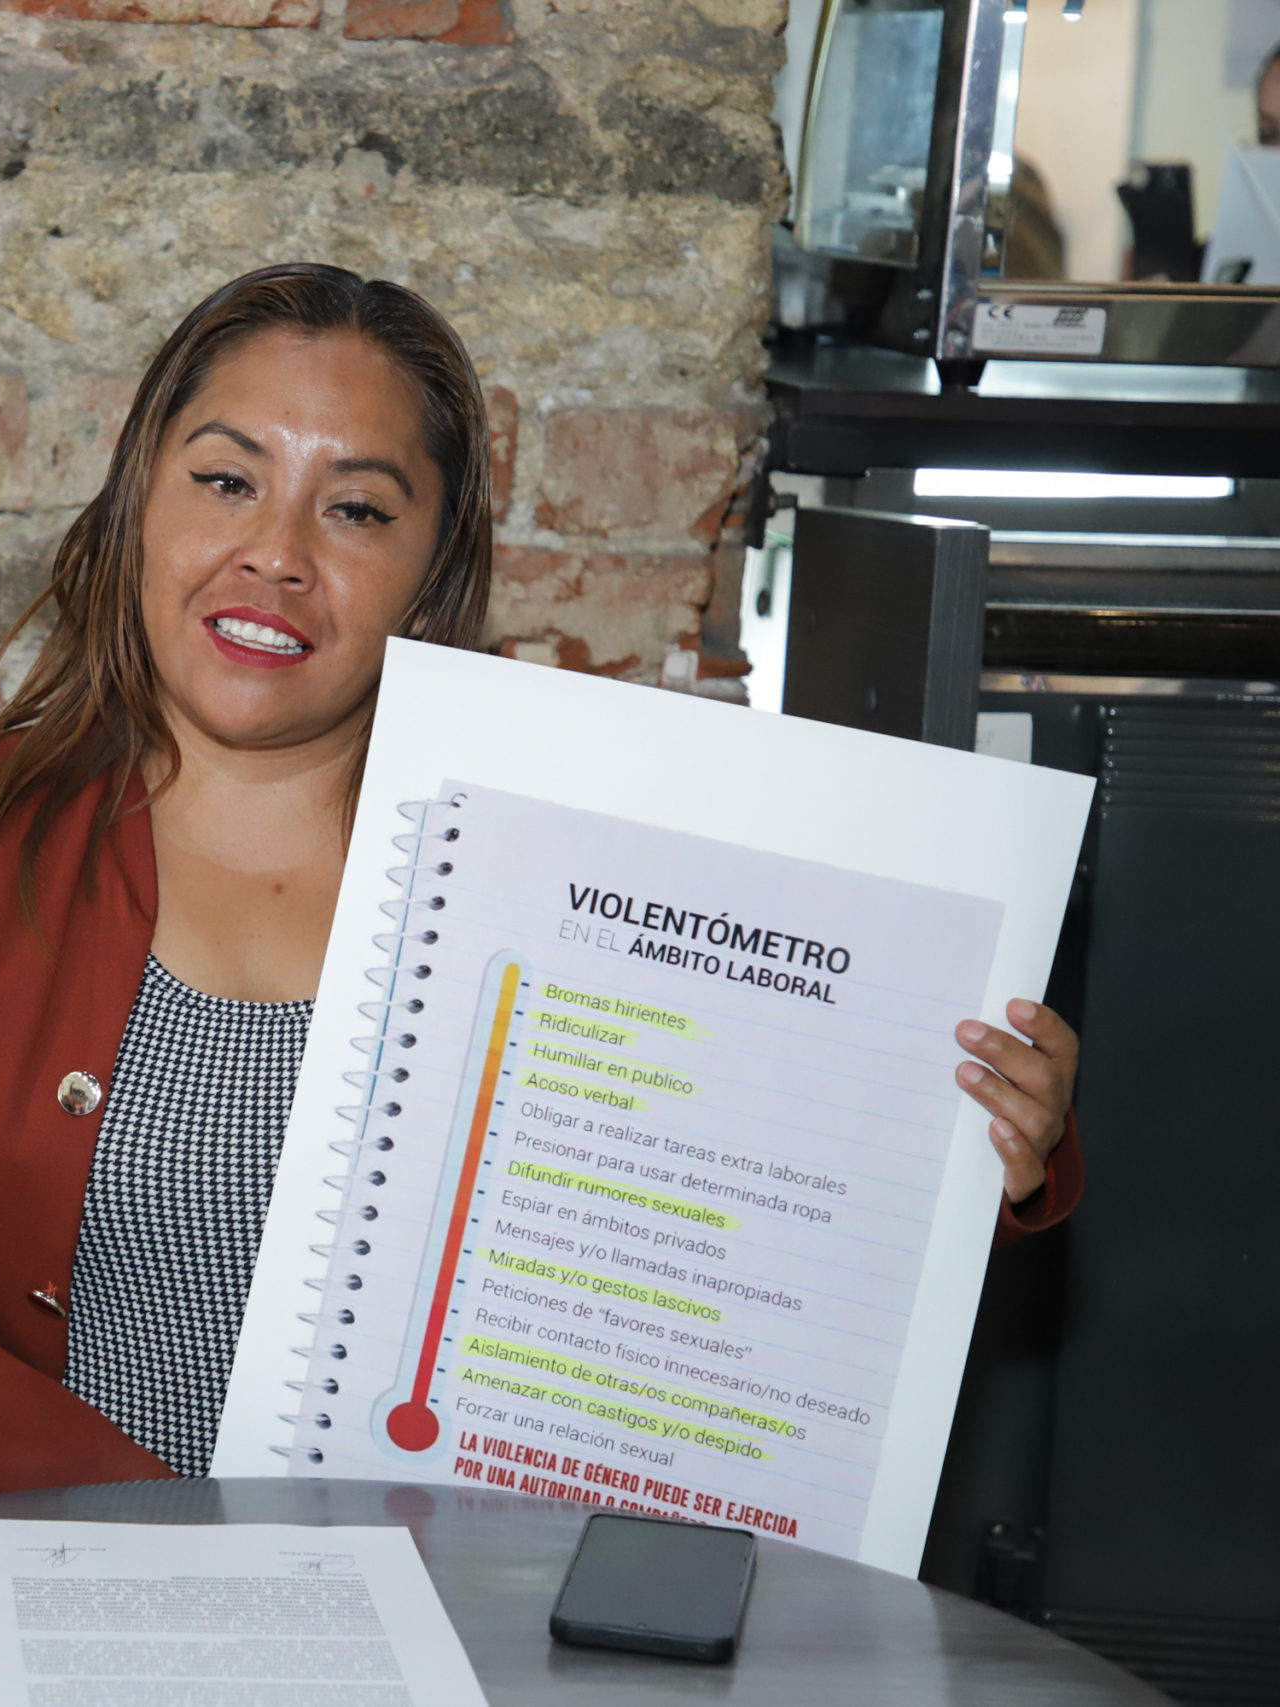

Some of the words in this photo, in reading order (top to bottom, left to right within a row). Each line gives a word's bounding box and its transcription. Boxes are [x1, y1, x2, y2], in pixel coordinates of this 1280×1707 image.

[558, 919, 591, 944] EN
[596, 928, 621, 952] EL
[627, 932, 721, 975] ÁMBITO
[725, 960, 836, 1005] LABORAL
[569, 882, 851, 975] VIOLENTÓMETRO
[539, 1012, 627, 1046] Ridiculizar
[545, 983, 611, 1012] Bromas
[614, 999, 687, 1031] hirientes
[526, 1072, 579, 1097] Acoso
[583, 1088, 635, 1111] verbal
[533, 1042, 603, 1072] Humillar
[607, 1063, 628, 1079] en
[631, 1069, 693, 1094] publico
[514, 1130, 594, 1163] Presionar
[596, 1154, 635, 1174] para
[639, 1165, 677, 1184] usar
[680, 1172, 788, 1213] determinada
[792, 1203, 832, 1223] ropa
[520, 1102, 580, 1128] Obligar
[583, 1119, 594, 1133] a
[598, 1123, 660, 1148] realizar
[664, 1137, 716, 1163] tareas
[720, 1154, 763, 1175] extra
[768, 1162, 847, 1196] laborales
[501, 1189, 554, 1215] Espiar
[557, 1207, 578, 1222] en
[581, 1213, 650, 1241] ámbitos
[653, 1231, 727, 1260] privados
[507, 1160, 574, 1189] Difundir
[577, 1180, 648, 1208] rumores
[651, 1199, 726, 1229] sexuales
[482, 1277, 568, 1313] Peticiones
[572, 1301, 593, 1320] de
[488, 1248, 557, 1279] Miradas
[559, 1269, 588, 1287] y/o
[591, 1278, 649, 1303] gestos
[652, 1289, 721, 1322] lascivos
[495, 1219, 575, 1252] Mensajes
[578, 1243, 607, 1260] y/o
[610, 1247, 688, 1281] llamadas
[691, 1272, 802, 1311] inapropiadas
[468, 1338, 567, 1375] Aislamiento
[571, 1363, 592, 1382] de
[595, 1373, 667, 1402] otras/os
[670, 1393, 807, 1441] compañeras/os
[475, 1307, 533, 1335] Recibir
[537, 1326, 611, 1355] contacto
[615, 1342, 660, 1369] físico
[664, 1359, 792, 1404] innecesario/no
[795, 1392, 871, 1425] deseado
[455, 1396, 510, 1423] Forzar
[513, 1414, 545, 1433] una
[548, 1423, 615, 1451] relación
[619, 1442, 675, 1467] sexual
[461, 1367, 548, 1401] Amenazar
[551, 1392, 582, 1411] con
[586, 1401, 658, 1432] castigos
[661, 1421, 690, 1440] y/o
[694, 1428, 762, 1460] despido
[453, 1455, 483, 1481] POR
[486, 1464, 516, 1489] UNA
[458, 1430, 478, 1453] LA
[482, 1435, 558, 1473] VIOLENCIA
[560, 1455, 582, 1479] DE
[582, 1462, 641, 1494] GÉNERO
[642, 1477, 692, 1509] PUEDE
[692, 1492, 723, 1518] SER
[724, 1501, 798, 1539] EJERCIDA
